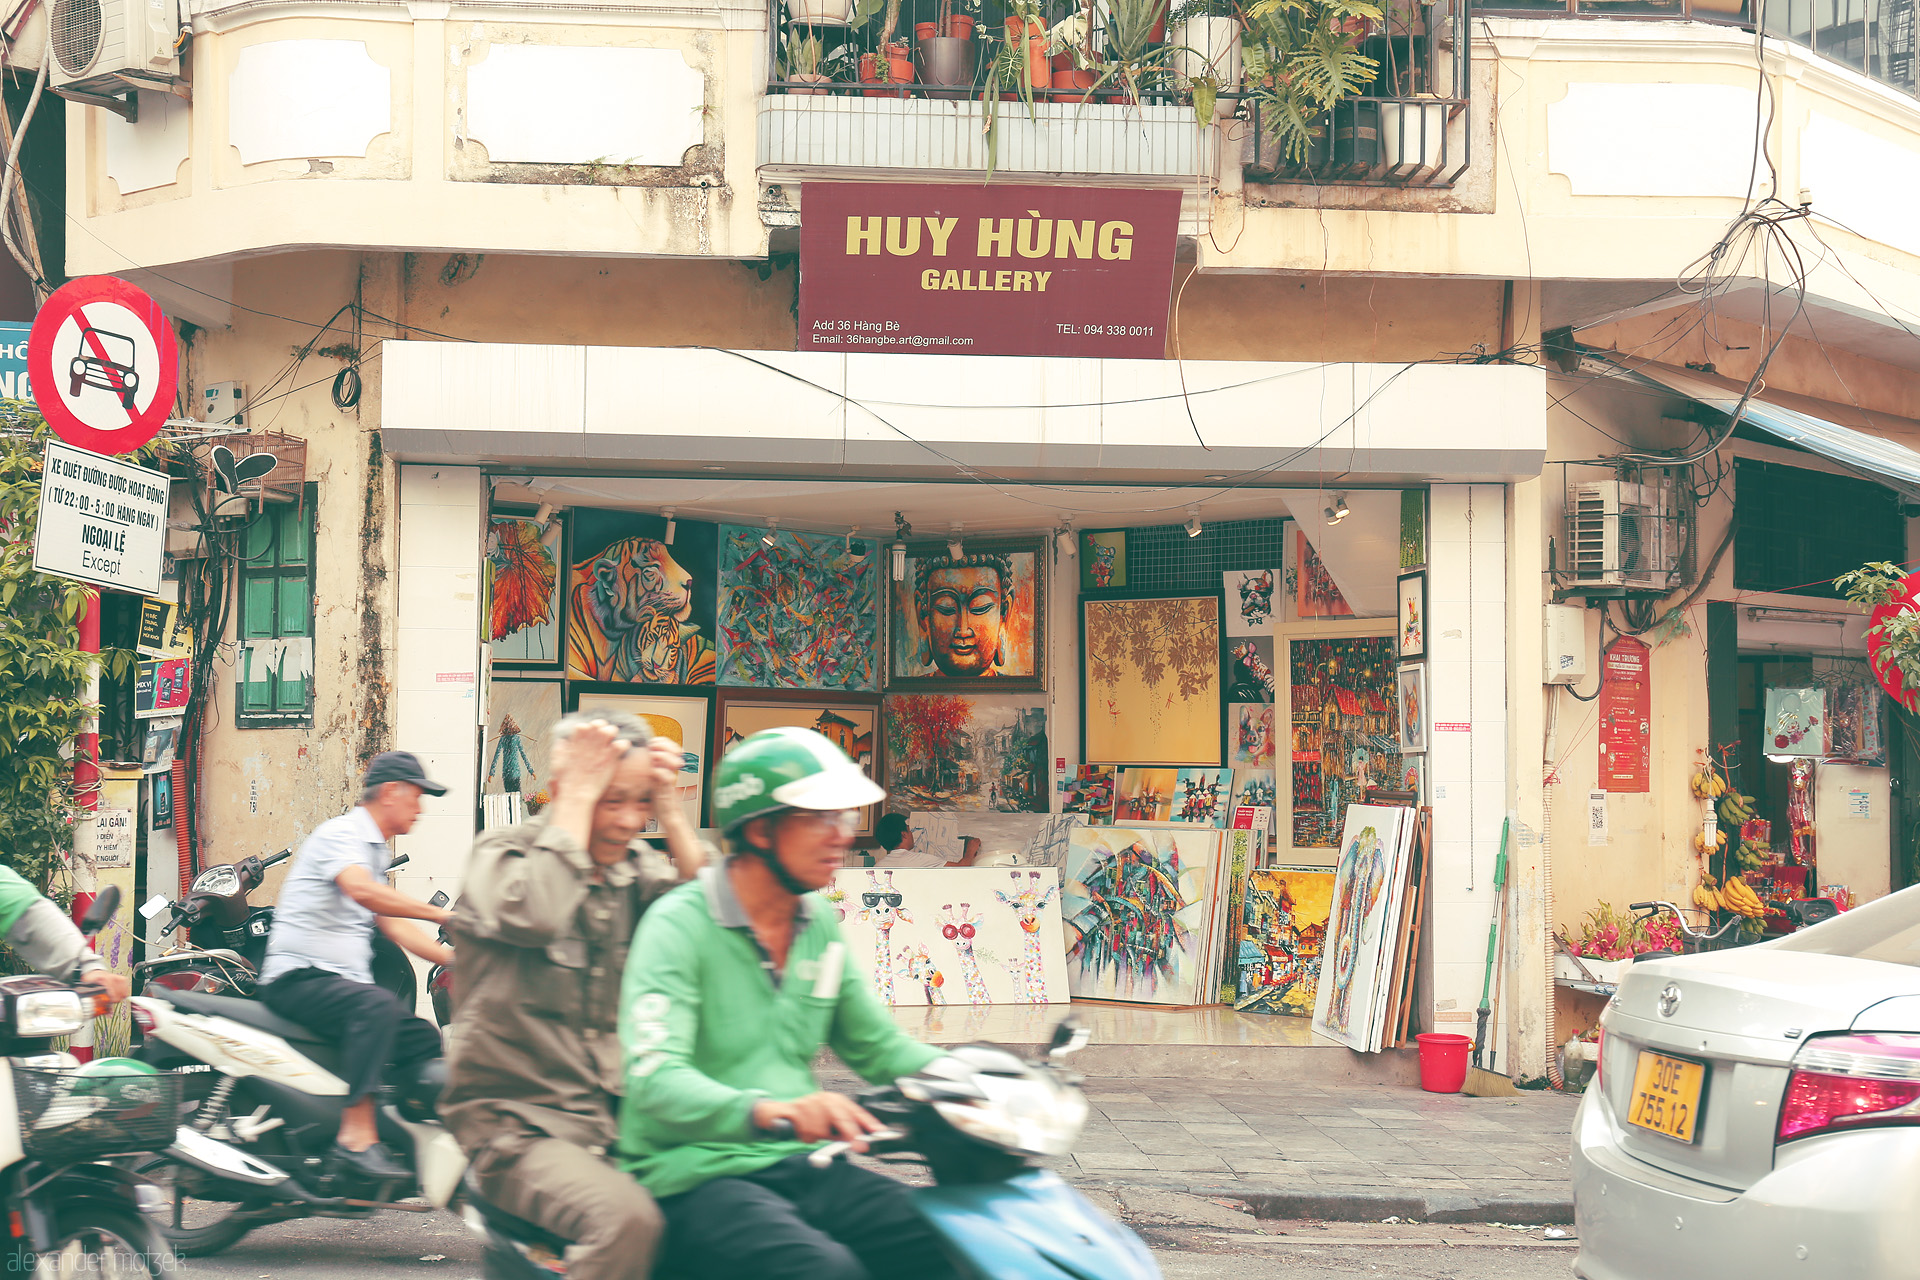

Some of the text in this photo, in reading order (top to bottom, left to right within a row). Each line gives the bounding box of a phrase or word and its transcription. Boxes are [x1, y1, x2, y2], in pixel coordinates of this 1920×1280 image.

[845, 209, 1135, 261] HUY HÙNG
[920, 268, 1052, 292] GALLERY
[812, 319, 900, 333] Add 36 Hàng Bè
[812, 334, 974, 347] Email: 36hangbe.art@gmail.com
[1056, 323, 1154, 337] TEL: 094 338 0011
[51, 457, 165, 505] XE QUÉT ĐƯỜNG ĐƯỢC HOẠT ĐỘNG
[116, 502, 136, 524] HÀNG
[81, 523, 126, 556] NGOẠI LỆ
[82, 549, 121, 578] Except
[1652, 1058, 1683, 1095] 30E
[1636, 1091, 1688, 1135] 755.12
